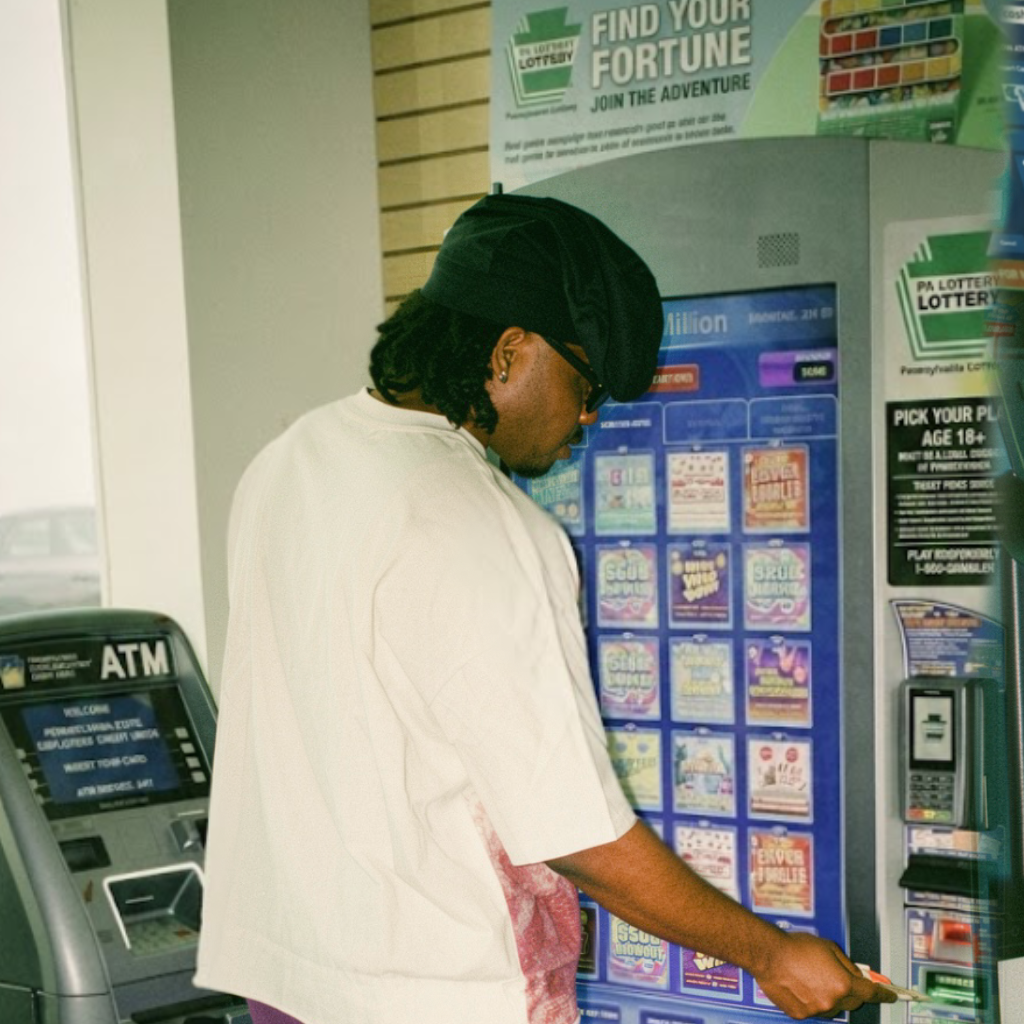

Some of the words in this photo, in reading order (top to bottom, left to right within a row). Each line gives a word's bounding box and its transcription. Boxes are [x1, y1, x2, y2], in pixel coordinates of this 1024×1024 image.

[593, 4, 660, 46] FIND
[669, 0, 751, 32] YOUR
[593, 25, 751, 88] FORTUNE
[590, 93, 625, 114] JOIN
[629, 85, 657, 107] THE
[660, 72, 751, 103] ADVENTURE
[916, 280, 935, 293] PA
[918, 289, 998, 311] LOTTERY
[894, 409, 929, 427] PICK
[932, 405, 973, 425] YOUR
[921, 429, 953, 447] AGE
[956, 427, 987, 447] 18+
[101, 640, 170, 681] ATM
